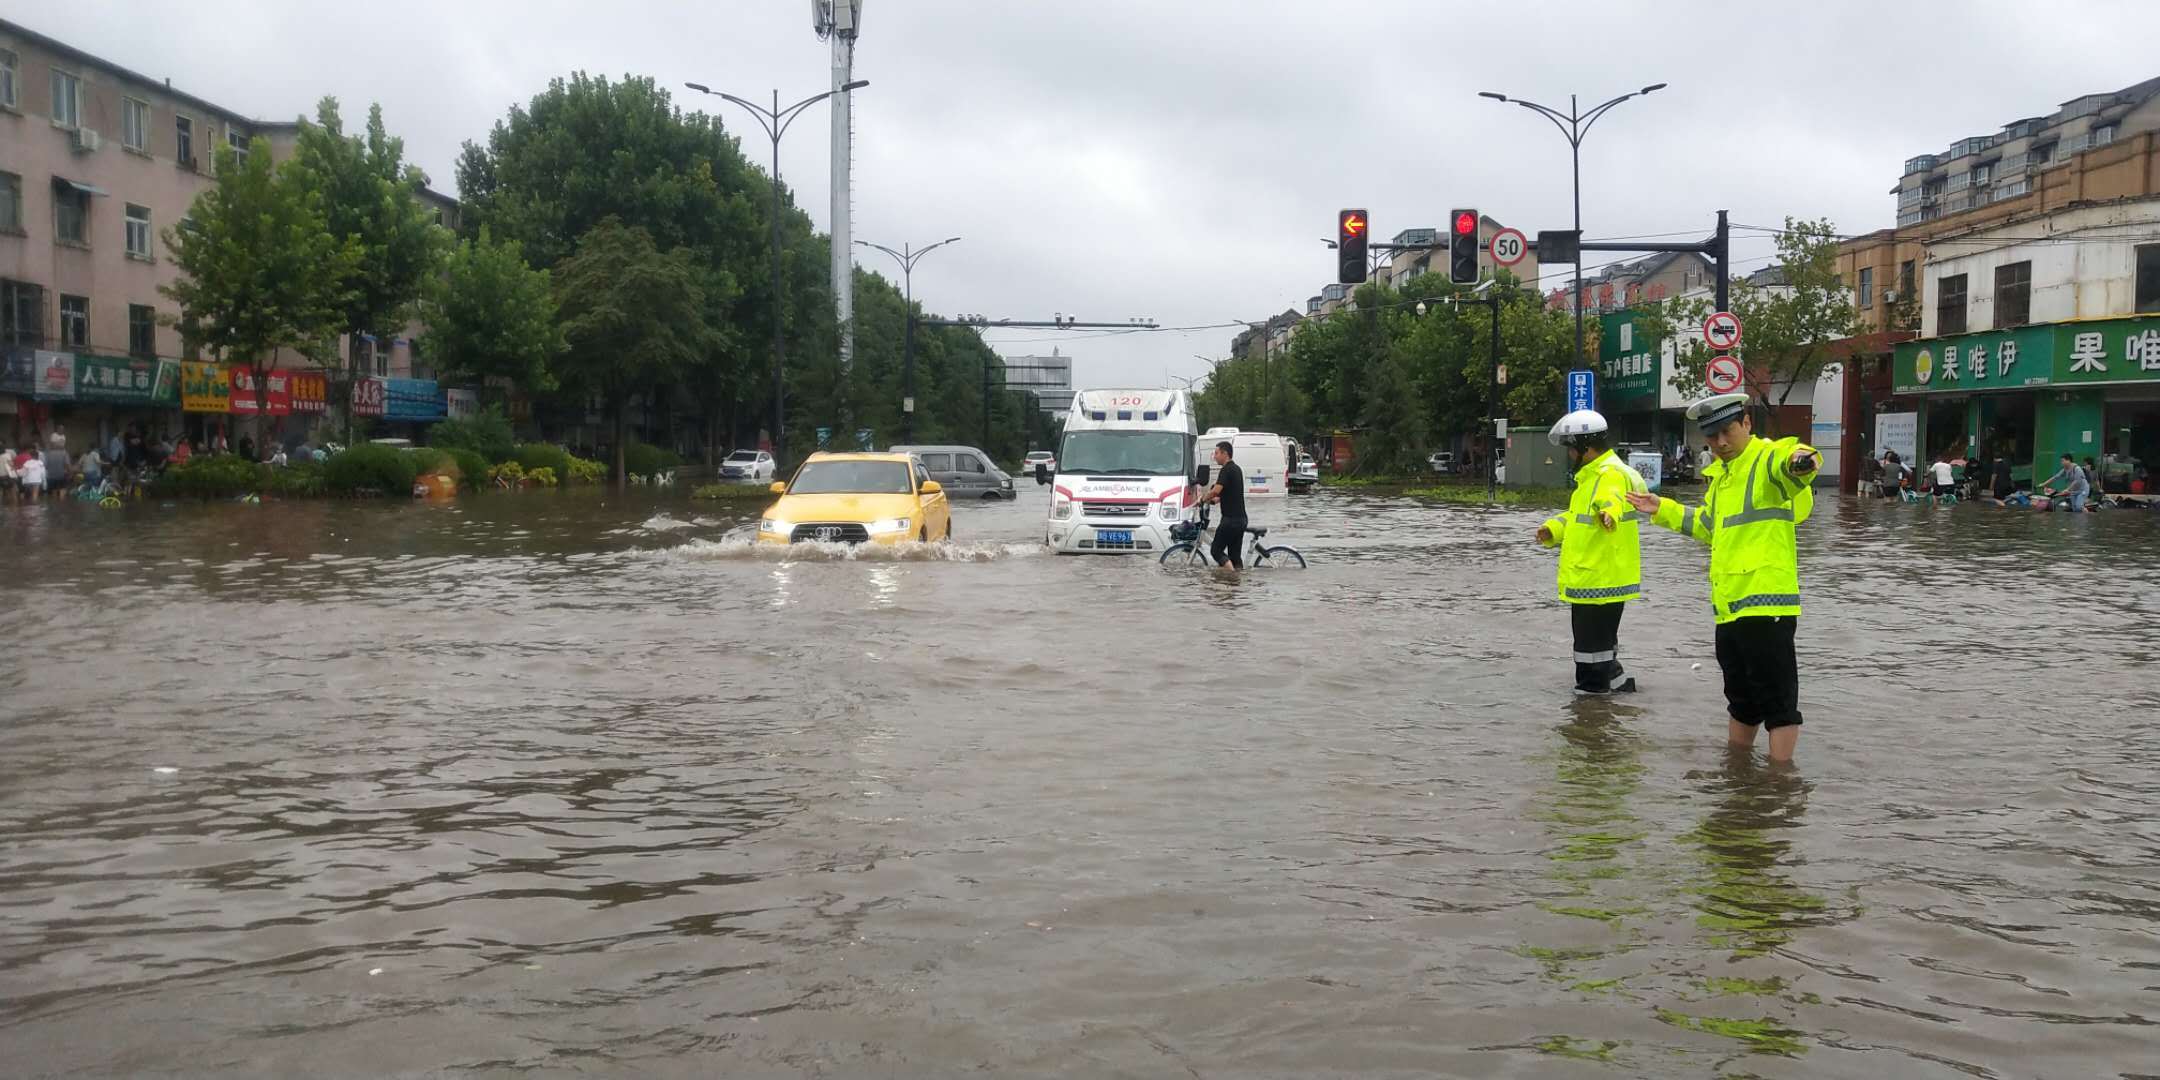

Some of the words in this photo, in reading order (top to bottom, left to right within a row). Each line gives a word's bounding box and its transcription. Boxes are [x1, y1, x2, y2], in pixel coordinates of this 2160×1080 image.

[1498, 240, 1519, 256] 50
[1941, 341, 2017, 380] 果唯伊
[1111, 397, 1141, 406] 120
[1574, 386, 1588, 410] 汴京
